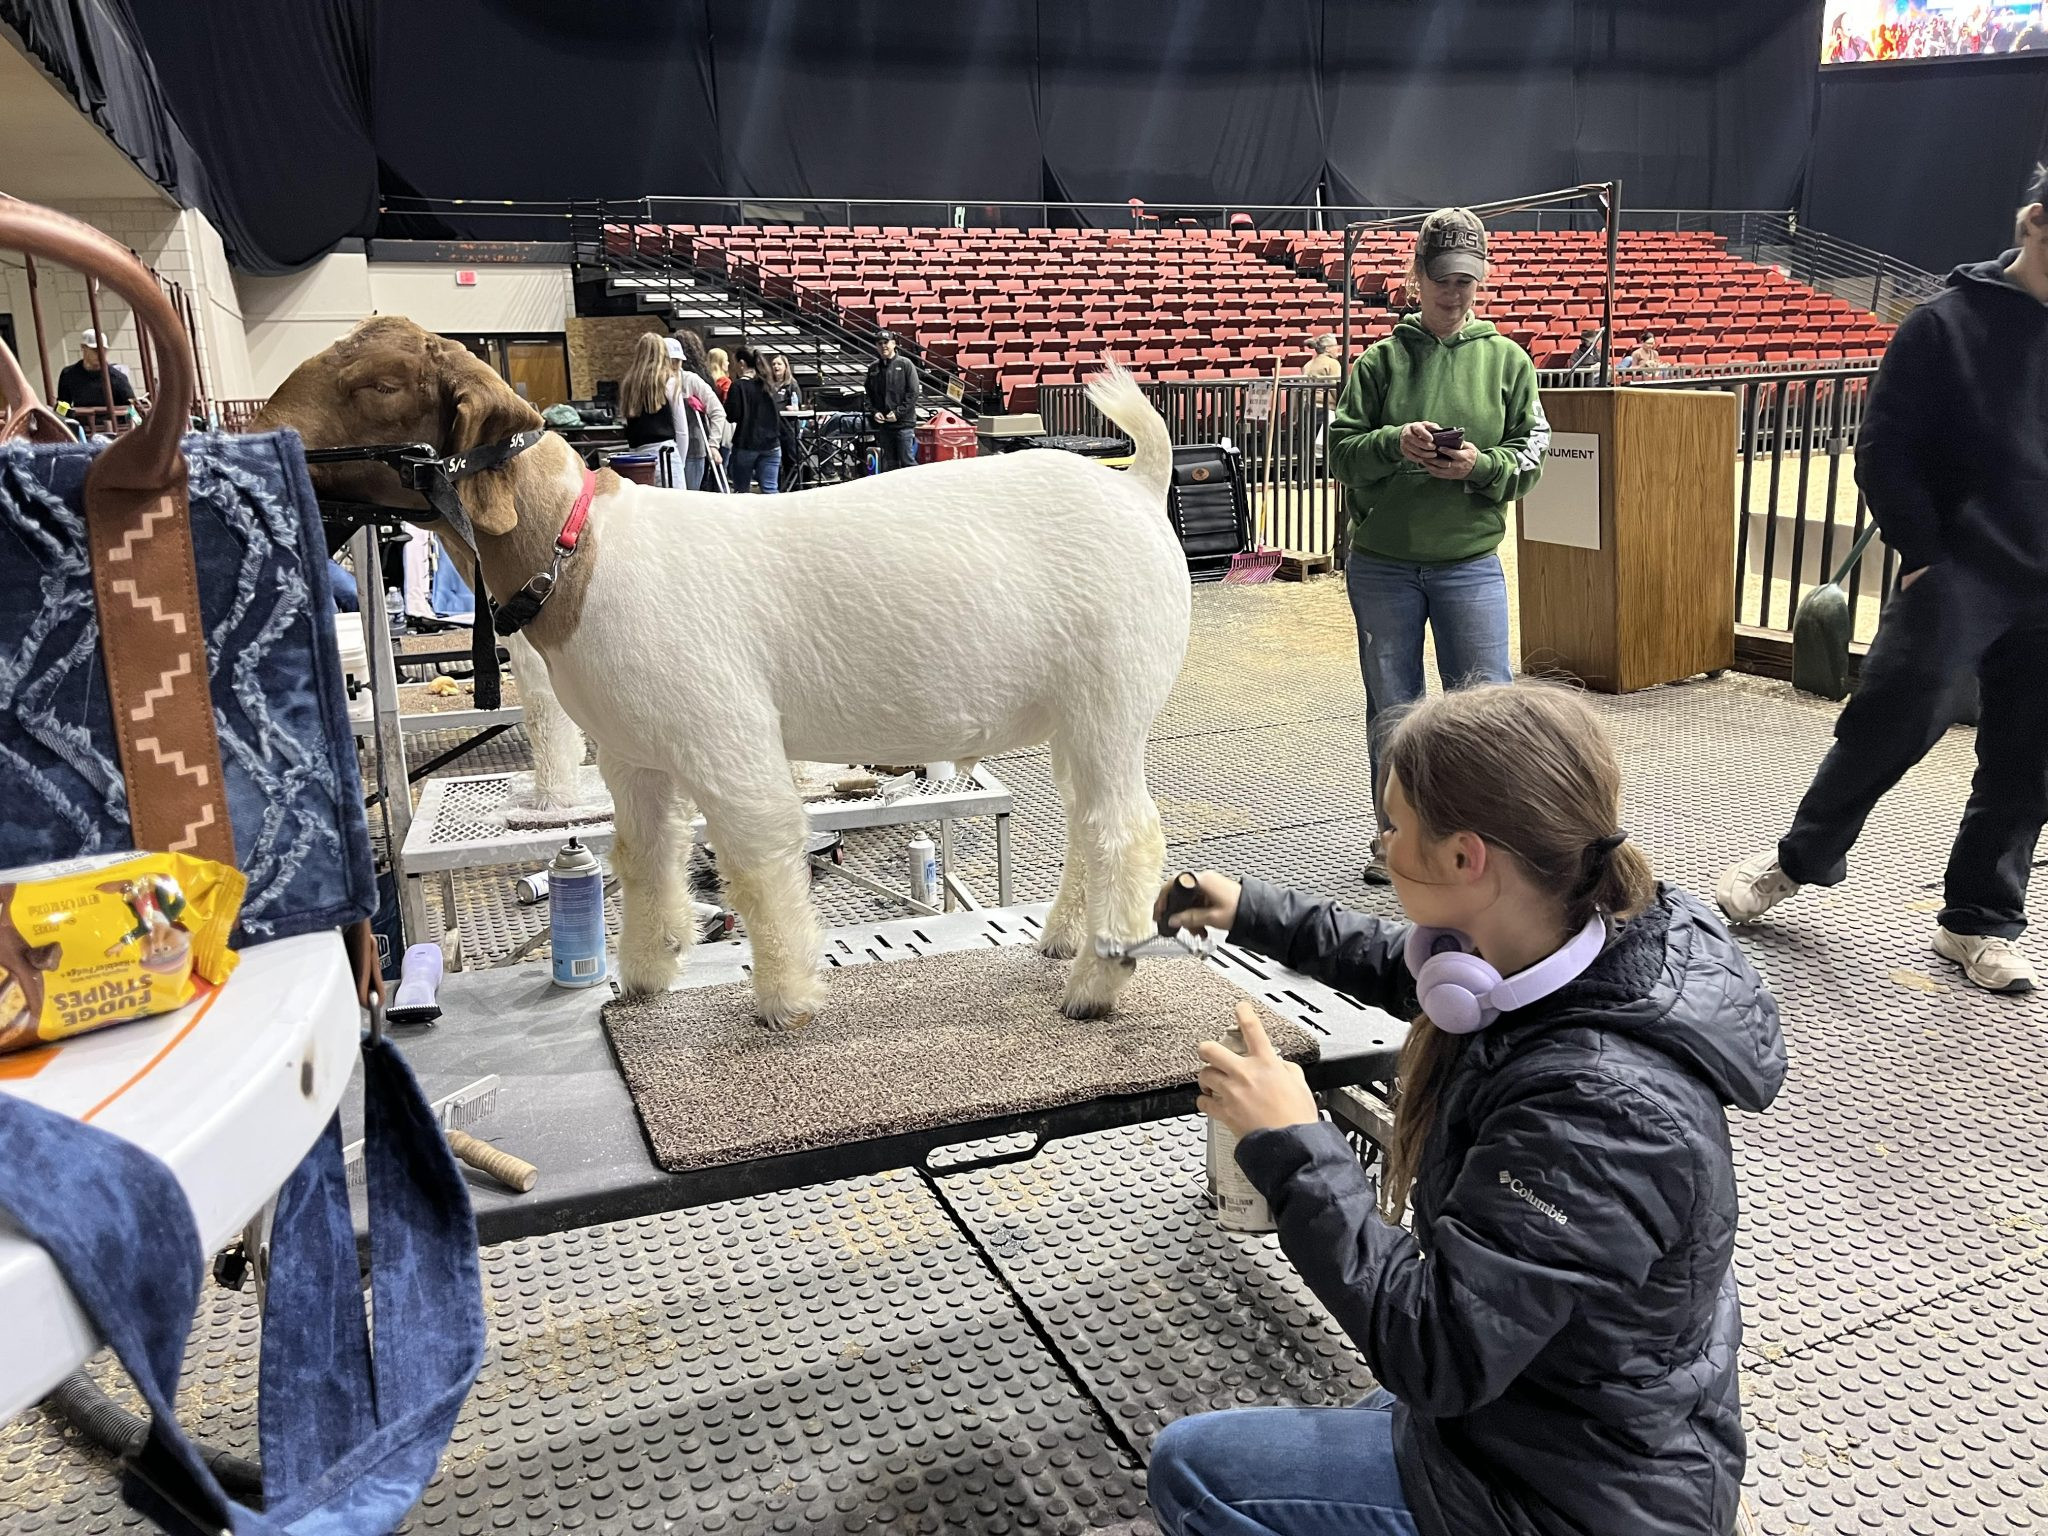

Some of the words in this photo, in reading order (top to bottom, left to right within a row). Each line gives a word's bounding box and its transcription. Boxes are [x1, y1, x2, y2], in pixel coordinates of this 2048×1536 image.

[1440, 230, 1478, 249] H&S
[53, 974, 153, 1012] STRIPES
[61, 989, 152, 1027] FUDGE
[1510, 1178, 1568, 1225] Columbia
